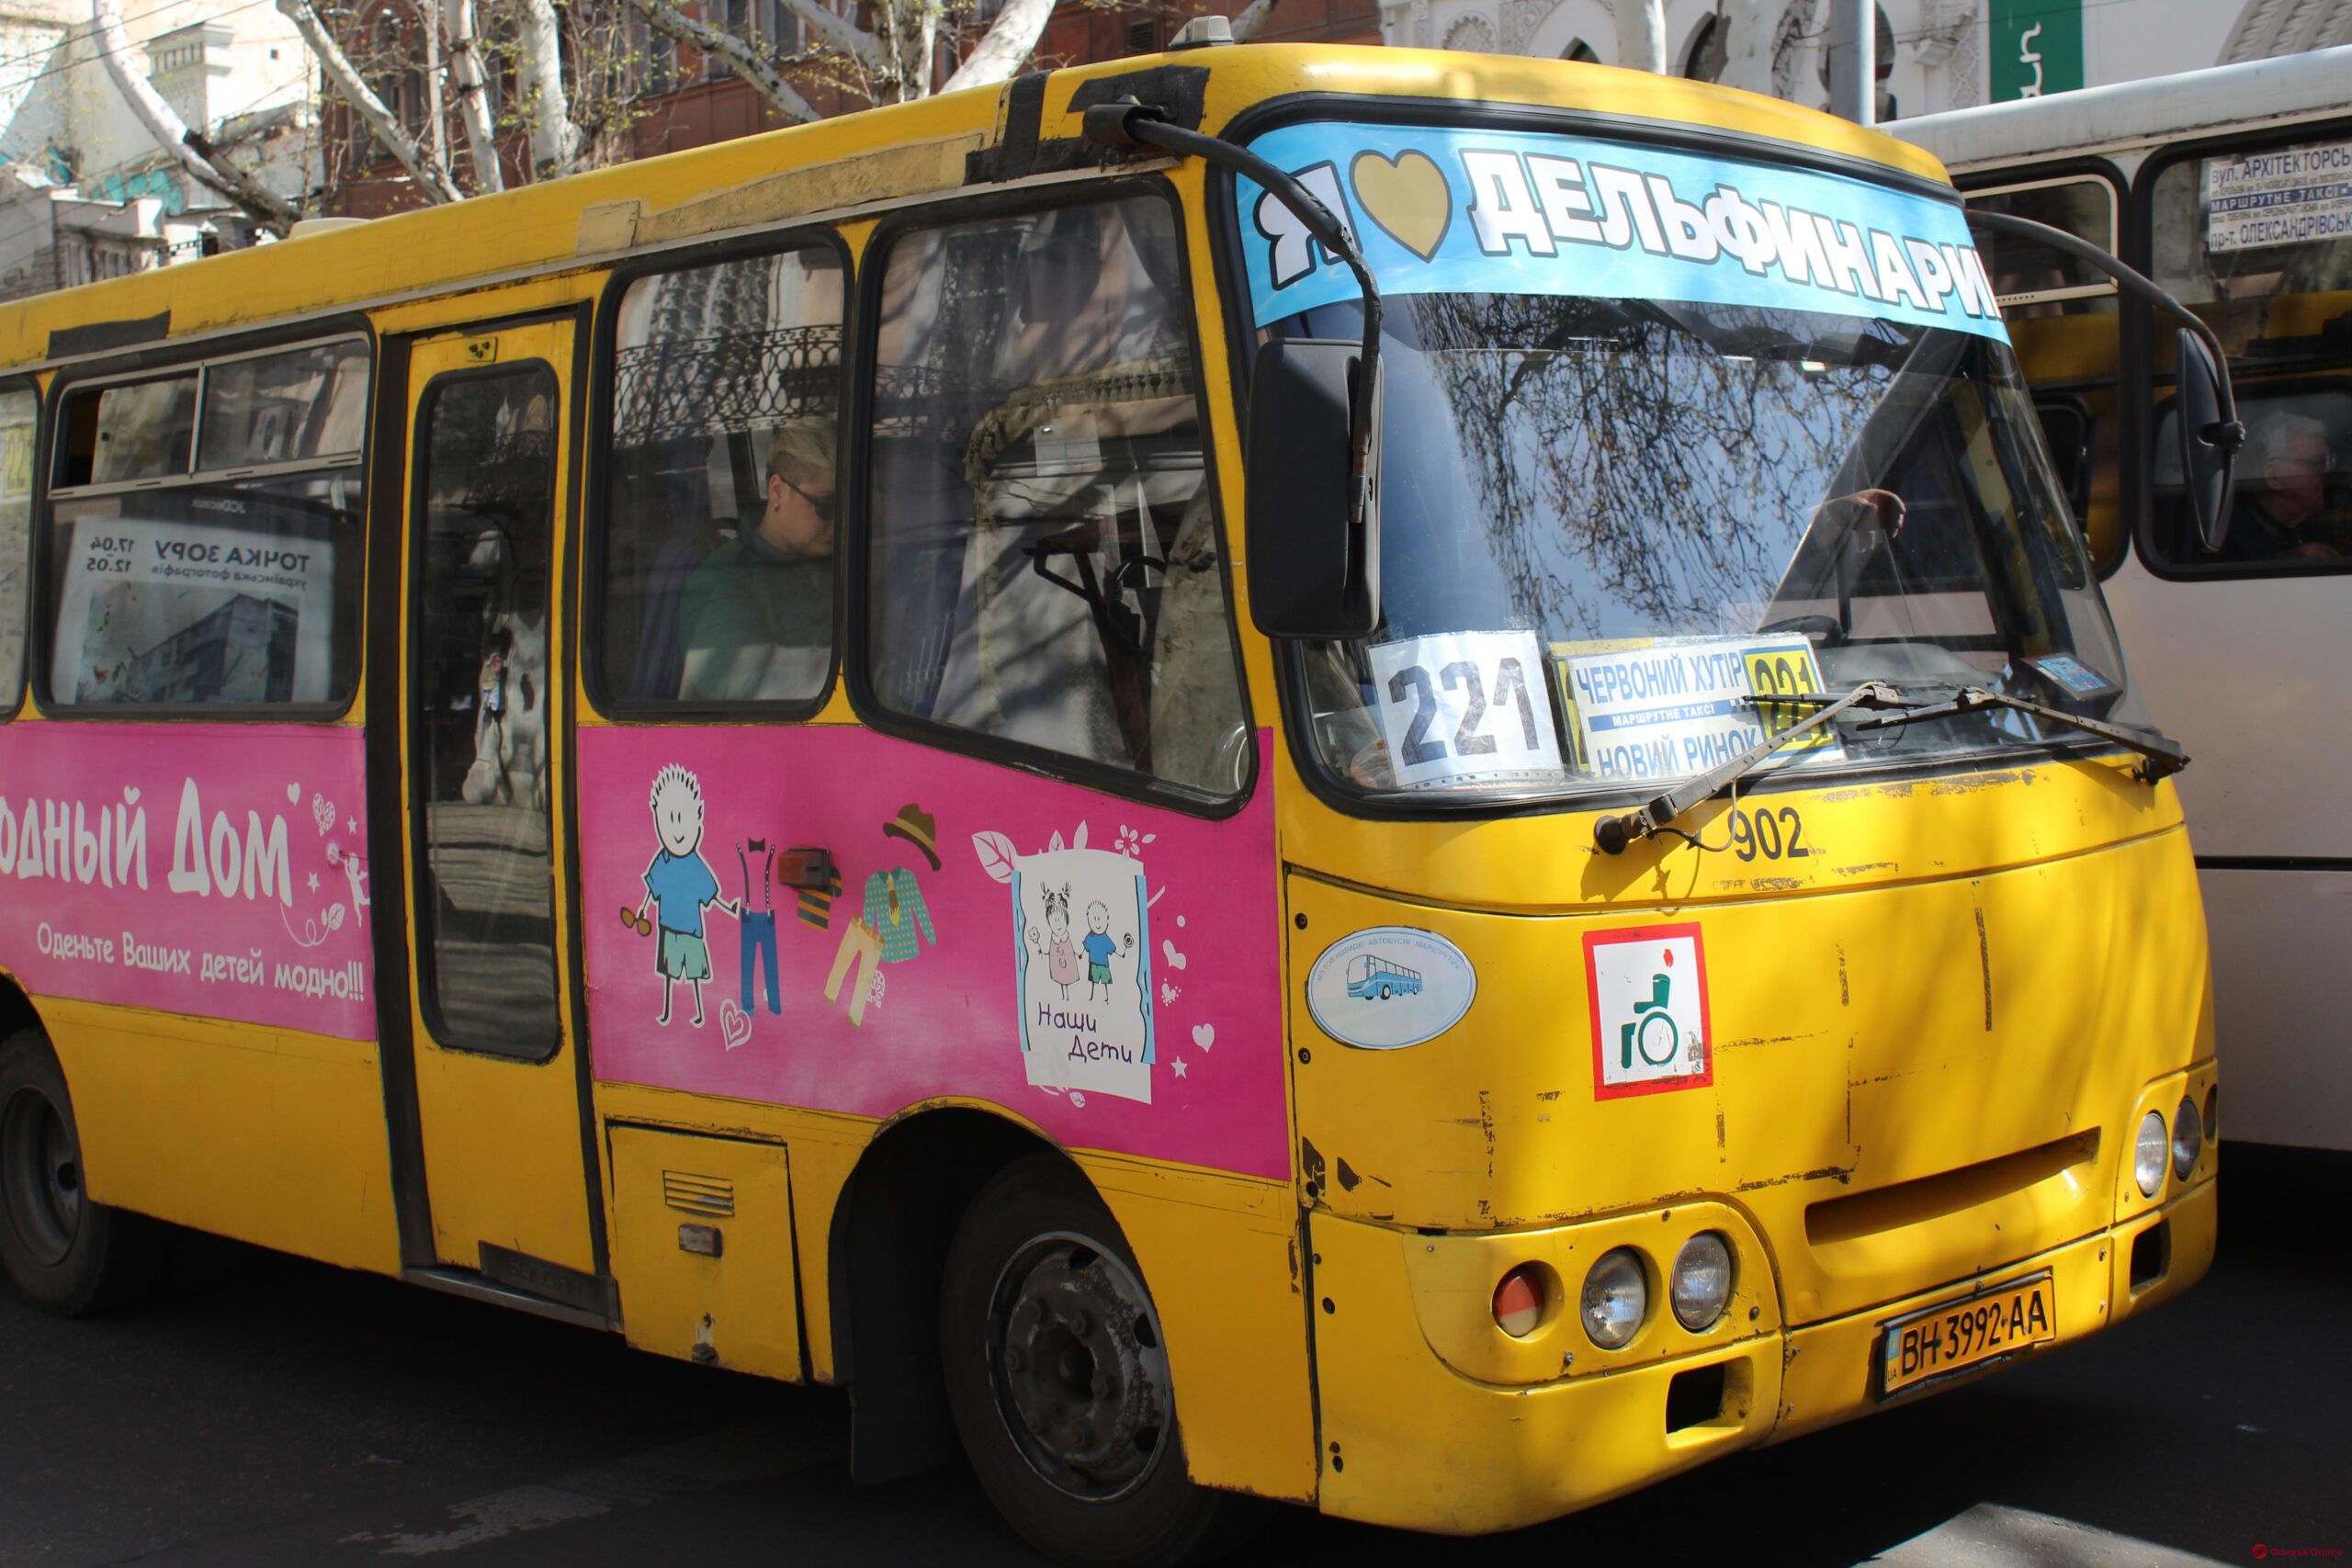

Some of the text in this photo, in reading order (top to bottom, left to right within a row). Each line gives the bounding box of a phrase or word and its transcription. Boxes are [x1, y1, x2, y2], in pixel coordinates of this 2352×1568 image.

[2211, 191, 2291, 212] МАРШРУТНЕ
[2299, 185, 2339, 201] ТАКСІ
[1252, 147, 2004, 323] Я ДЕЛЬФИНАРИ
[1576, 650, 1743, 705] ЧЕРВОНИЙ ХУТІР
[1754, 656, 1829, 742] 221
[1388, 657, 1541, 767] 221
[1612, 704, 1715, 728] МАРШРУТНЕ ТАКСІ
[1597, 728, 1759, 781] НОВИЙ РИНОК
[1726, 806, 1809, 863] 902
[37, 922, 365, 1001] Оденьте Ваших детей модно!!!
[1038, 1001, 1097, 1032] Наши
[1069, 1034, 1132, 1064] Дети
[1902, 1289, 2049, 1377] BH 3992 AA
[1887, 1368, 1898, 1382] UA
